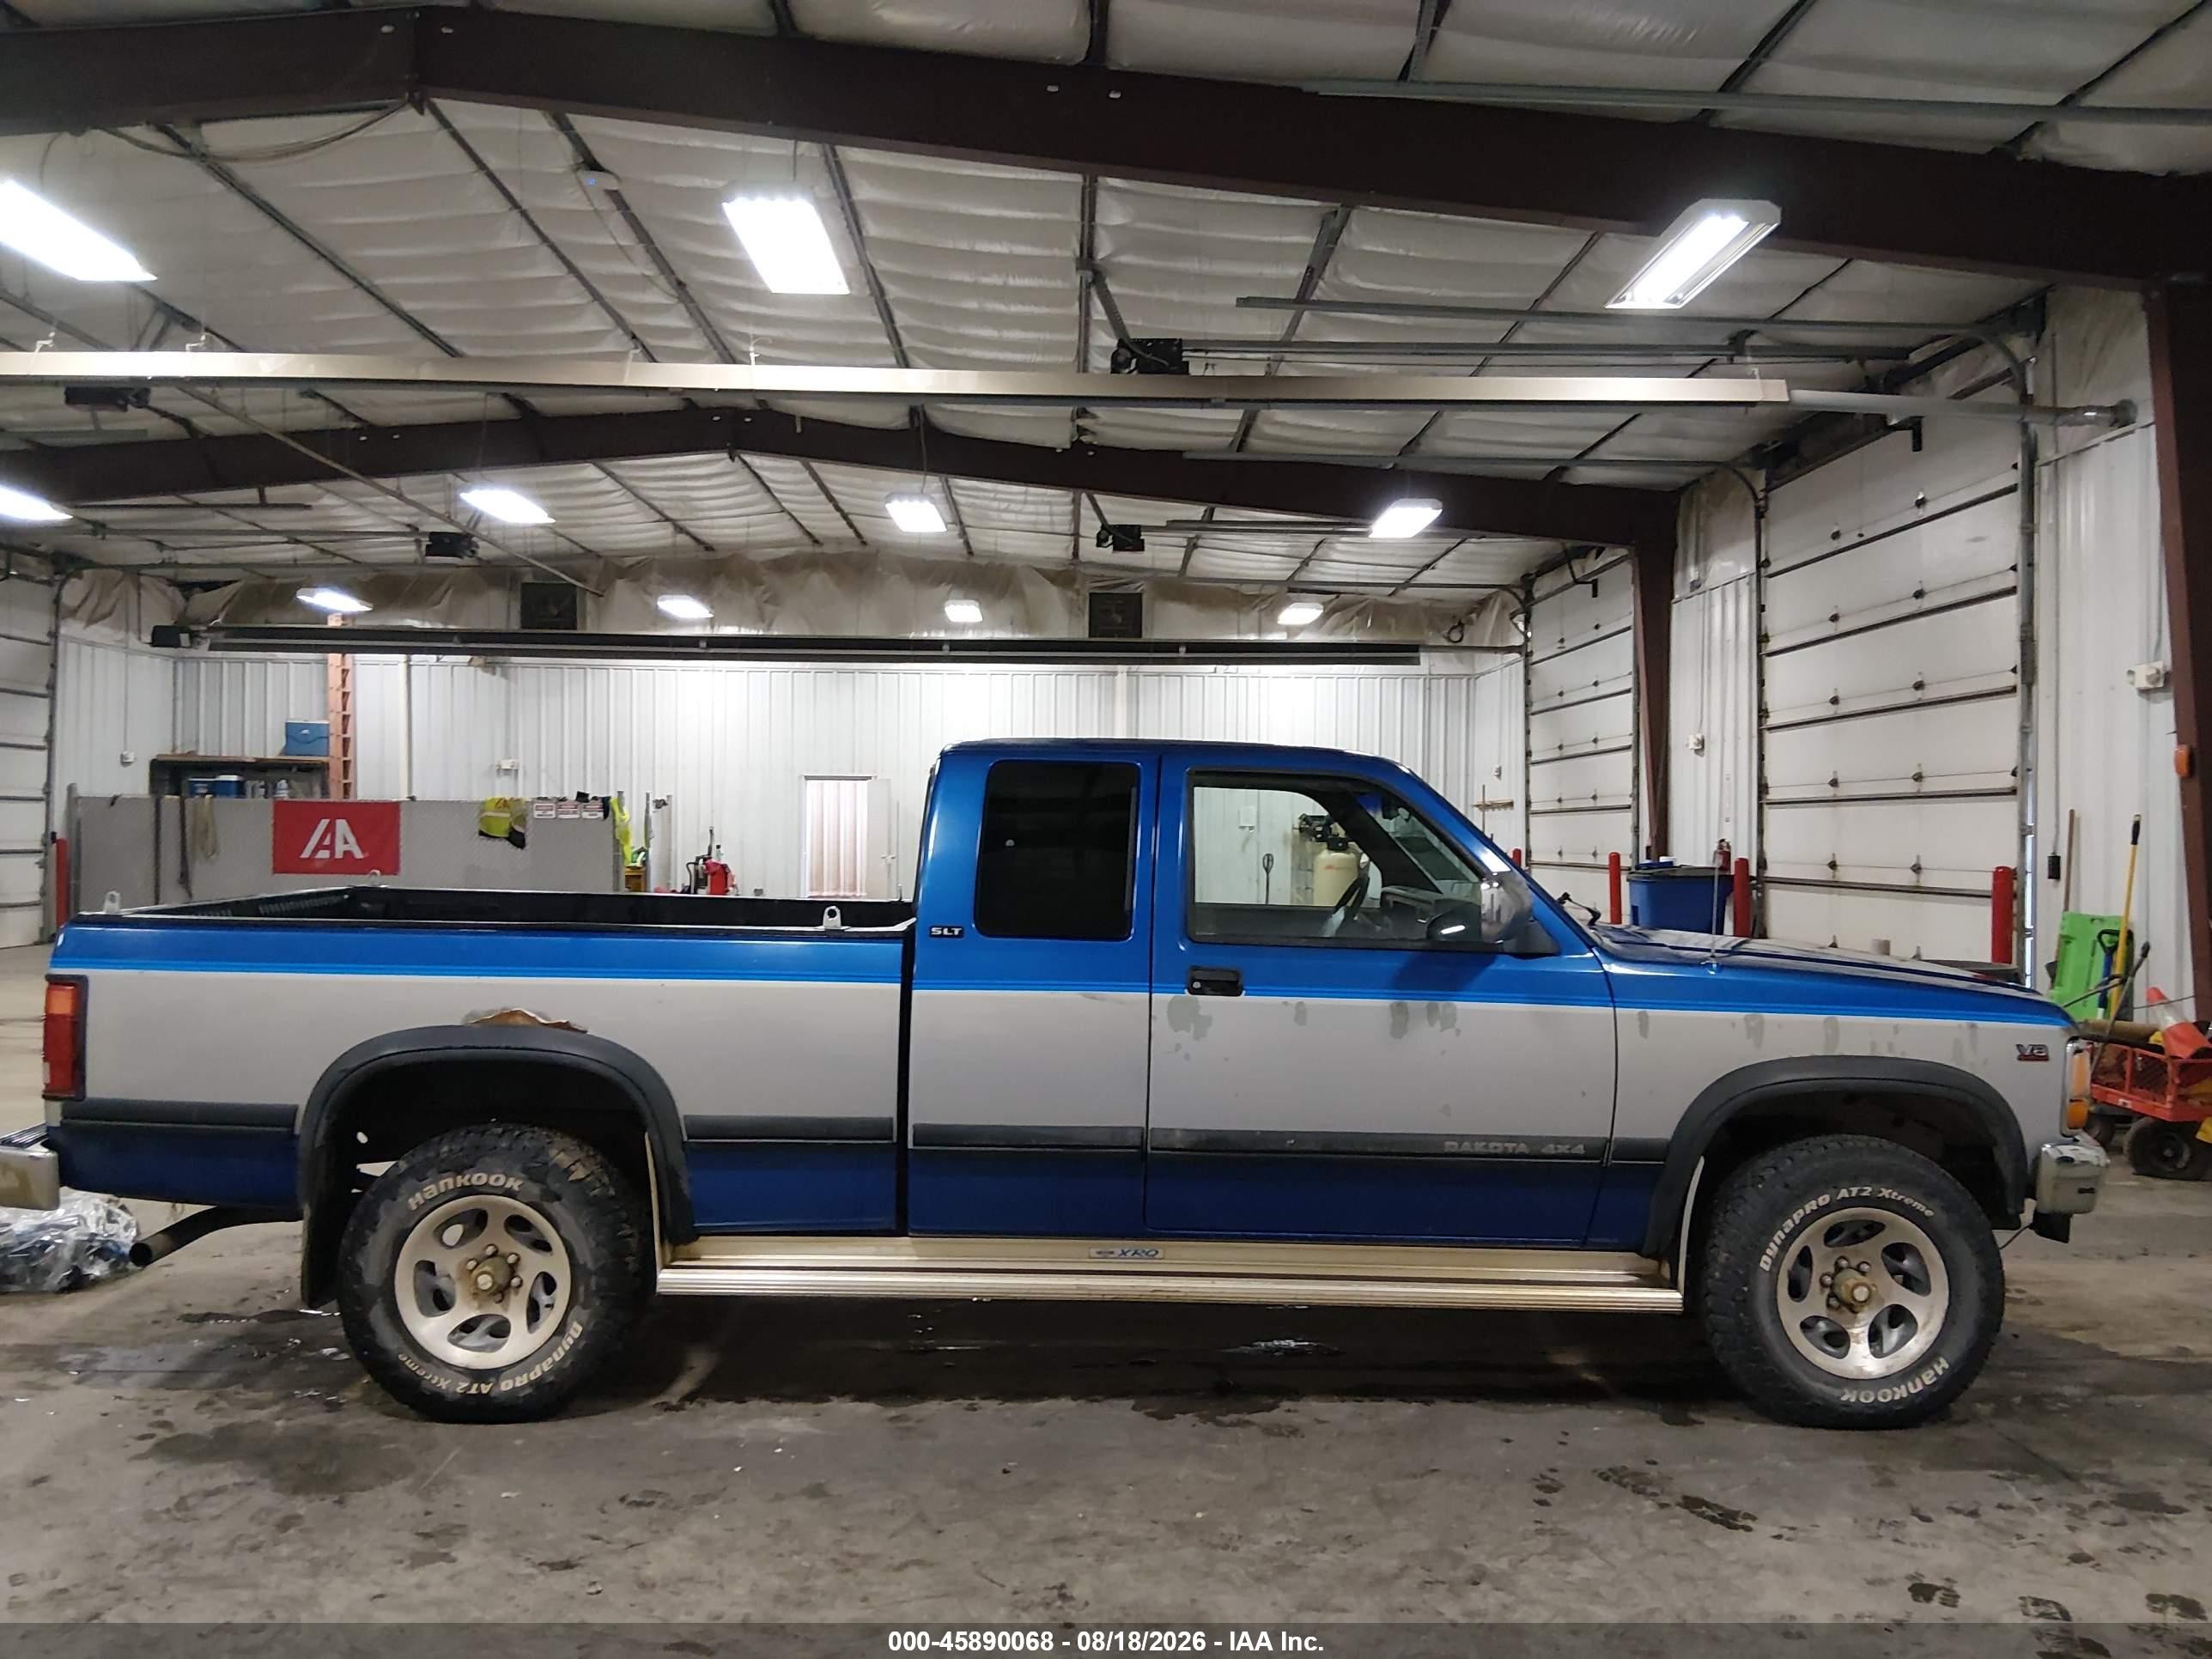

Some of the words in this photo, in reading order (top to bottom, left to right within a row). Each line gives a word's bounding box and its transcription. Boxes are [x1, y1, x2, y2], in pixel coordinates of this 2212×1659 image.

[931, 927, 963, 936] SLT
[1443, 1140, 1529, 1154] DAKOTA
[1836, 1186, 1874, 1200] AT2
[1878, 1188, 1935, 1217] Xtreme
[398, 1353, 452, 1390] Xtreme
[456, 1381, 494, 1395] AT2
